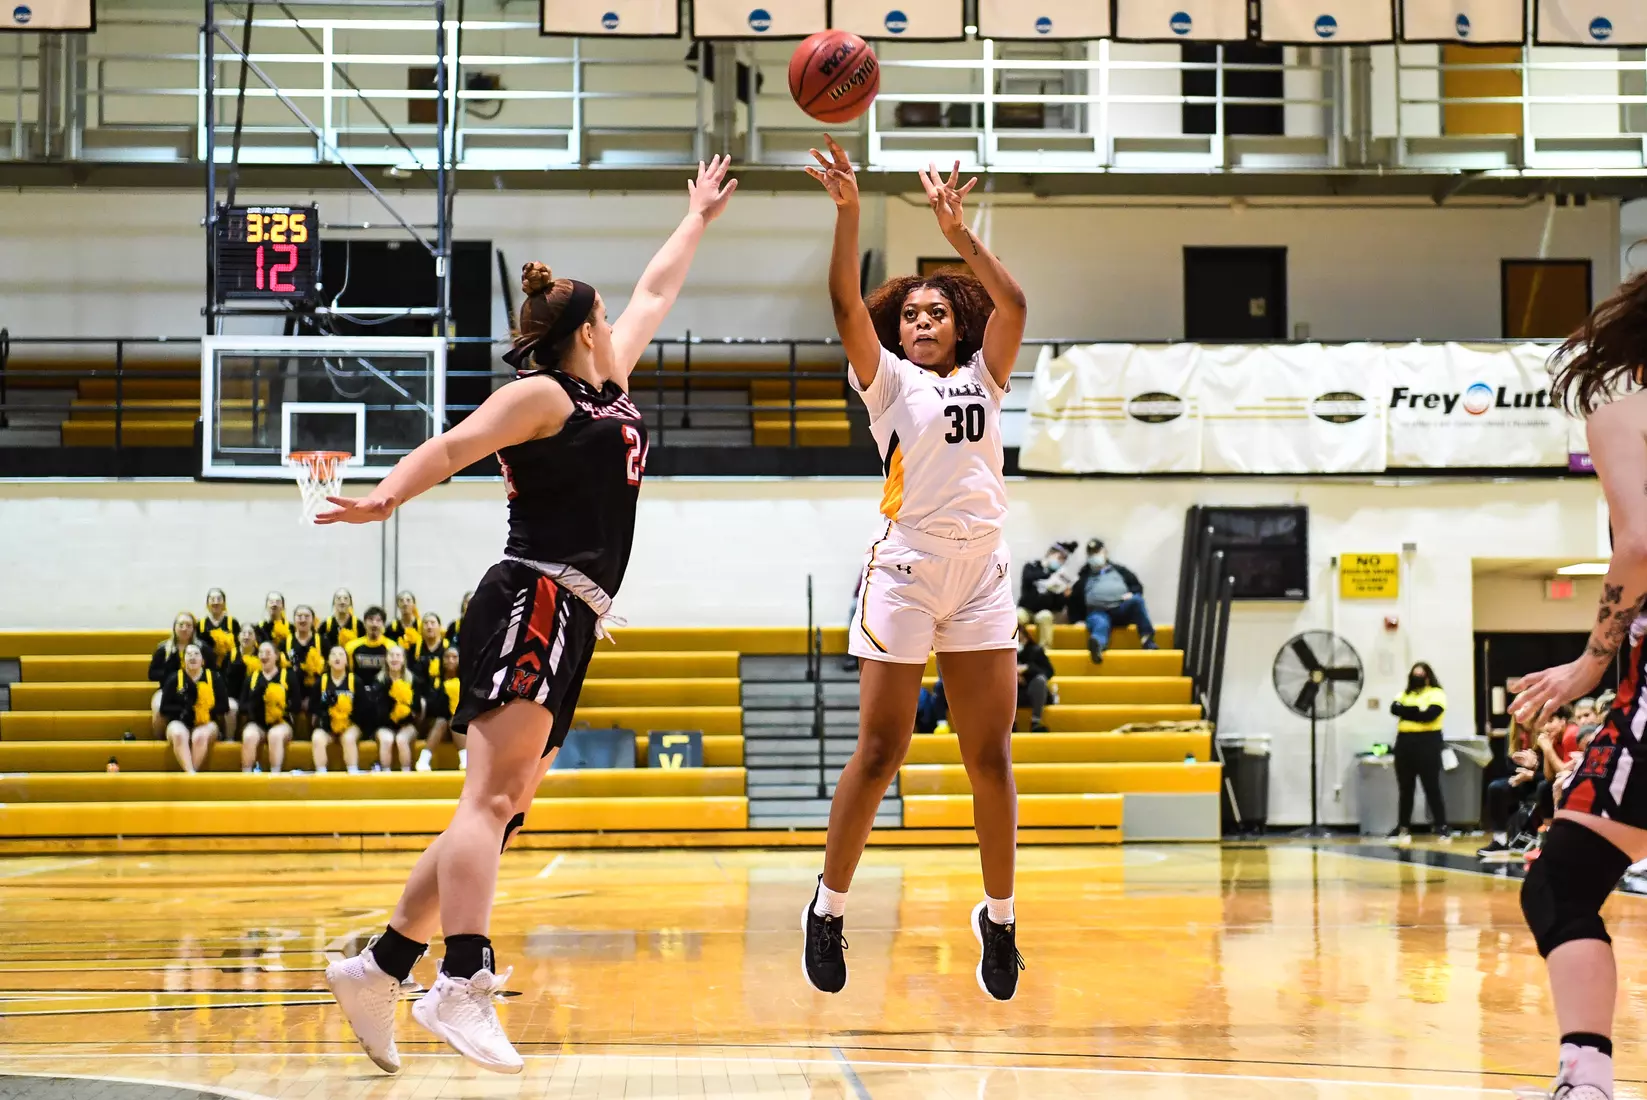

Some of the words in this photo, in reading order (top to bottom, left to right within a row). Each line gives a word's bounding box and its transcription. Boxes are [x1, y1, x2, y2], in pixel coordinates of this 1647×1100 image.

[818, 42, 857, 76] NCAA
[827, 56, 876, 103] Wilson
[246, 213, 308, 243] 3:25
[256, 243, 298, 292] 12
[1389, 386, 1461, 414] Frey
[944, 403, 986, 445] 30
